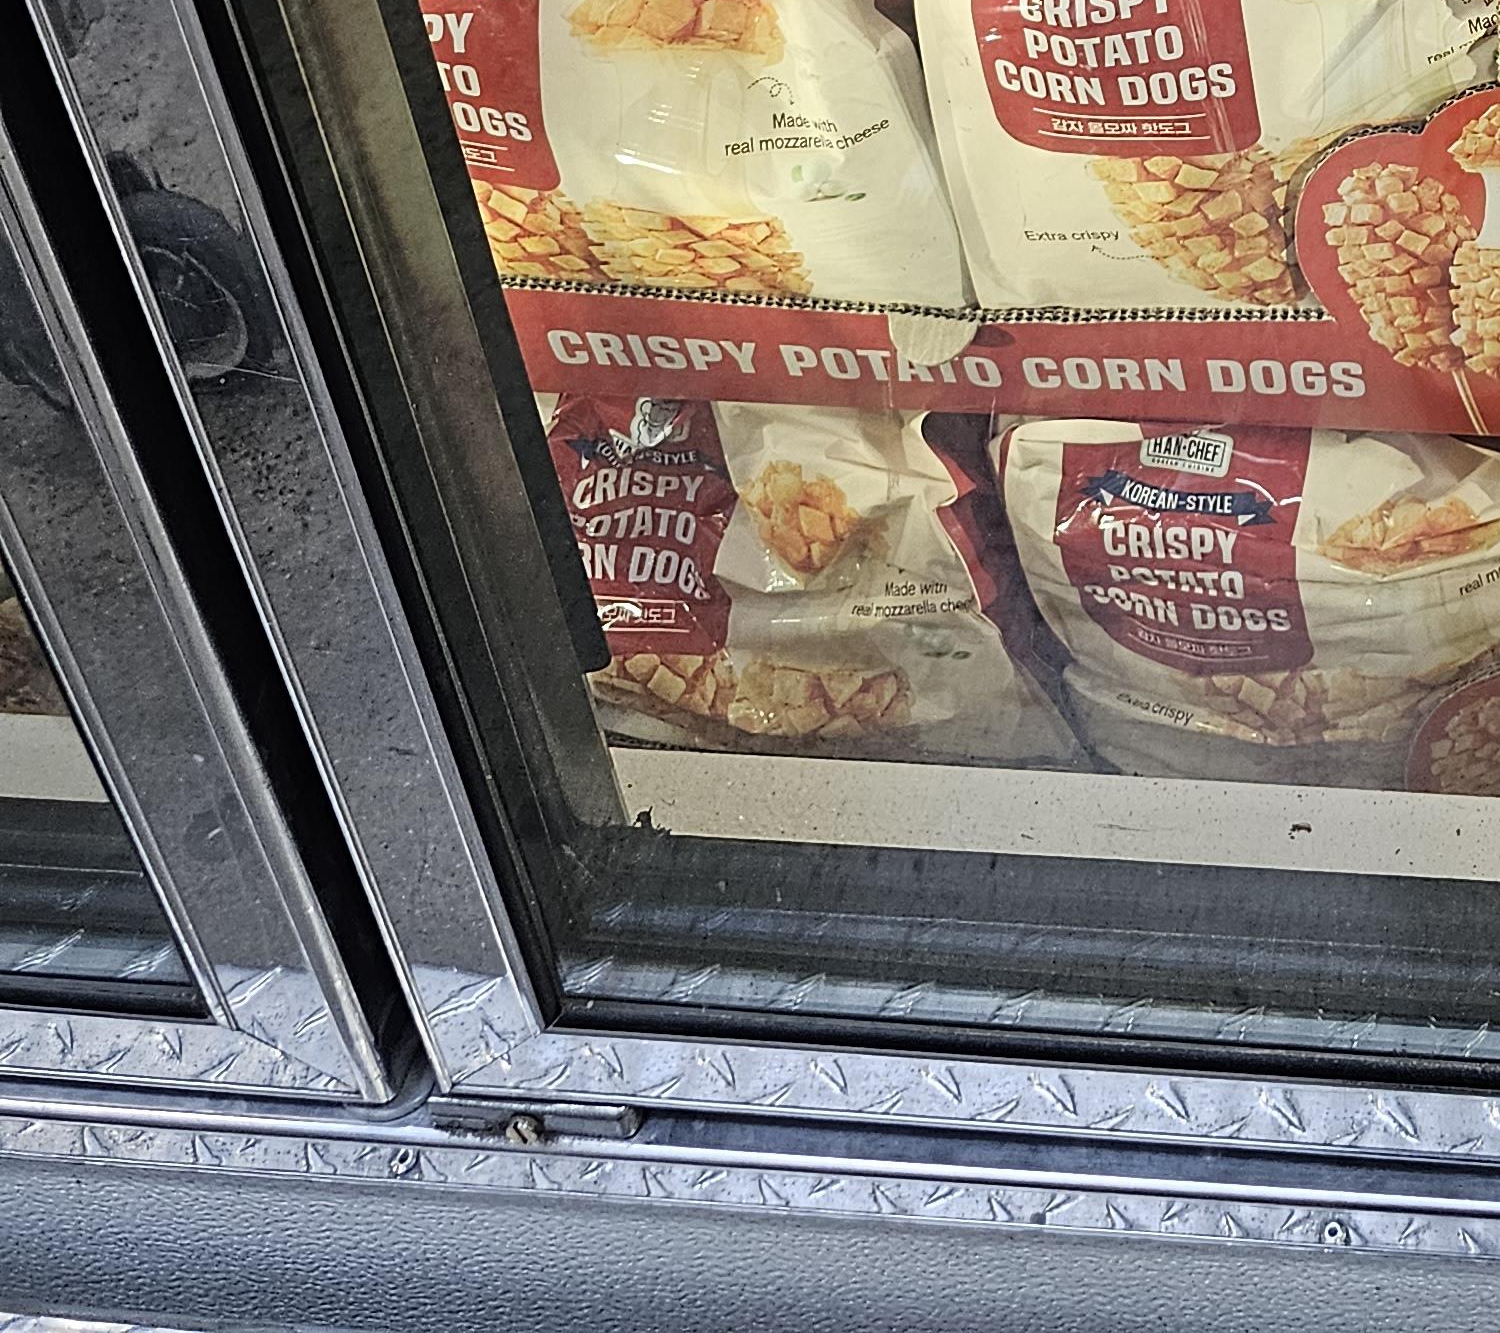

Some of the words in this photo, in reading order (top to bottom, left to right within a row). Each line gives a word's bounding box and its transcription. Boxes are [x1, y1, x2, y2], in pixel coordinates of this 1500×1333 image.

[1023, 24, 1184, 69] POTATO
[994, 58, 1106, 106] CORN
[1117, 62, 1237, 106] DOGS
[546, 330, 757, 374] CRISPY
[779, 344, 1002, 388] POTATO
[1025, 356, 1203, 393] CORN
[1207, 358, 1367, 398] DOGS
[1120, 478, 1233, 515] KOREAN-STYLE
[1103, 522, 1238, 565] CRISPY
